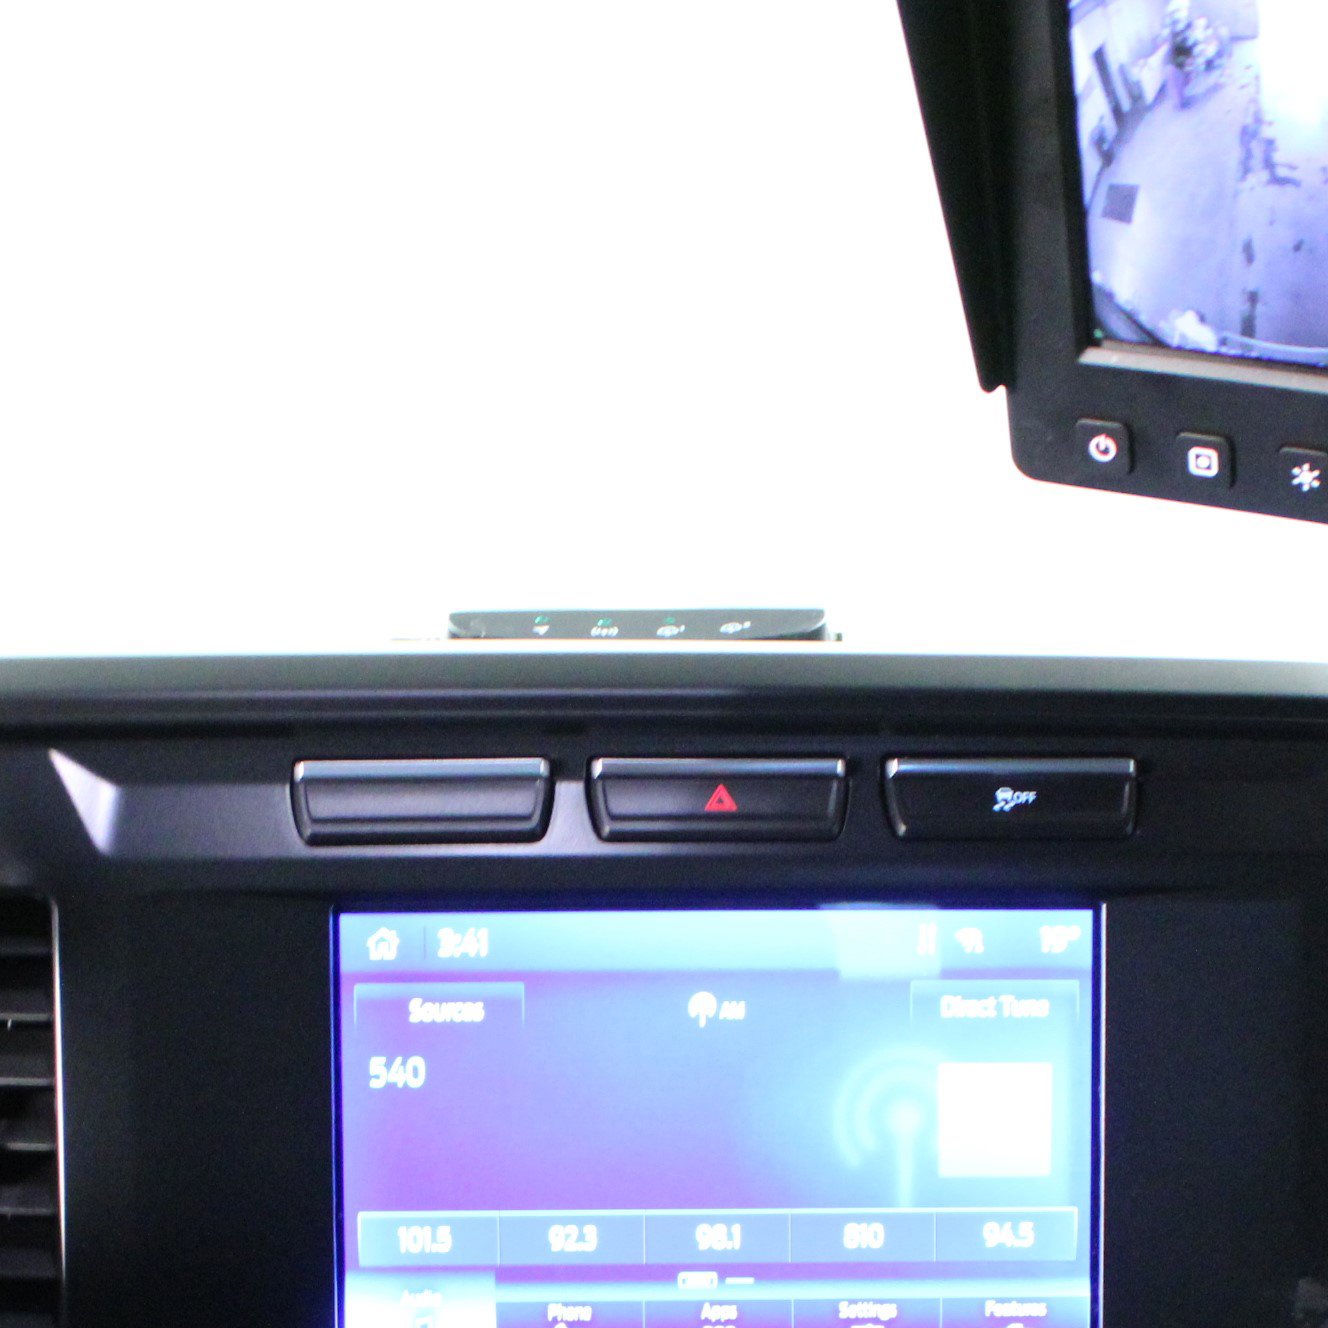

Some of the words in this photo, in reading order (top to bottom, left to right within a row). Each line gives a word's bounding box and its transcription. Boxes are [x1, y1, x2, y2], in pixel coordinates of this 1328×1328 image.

[408, 997, 485, 1023] Sources
[940, 995, 998, 1019] Direct
[999, 994, 1050, 1018] Tune
[369, 1056, 426, 1089] 540
[397, 1225, 453, 1254] 101.5
[548, 1224, 598, 1252] 92.3
[982, 1221, 1036, 1249] 94.5
[546, 1302, 593, 1323] Phone
[700, 1302, 739, 1323] Apps
[838, 1301, 898, 1321] Settings
[984, 1300, 1048, 1318] Features
